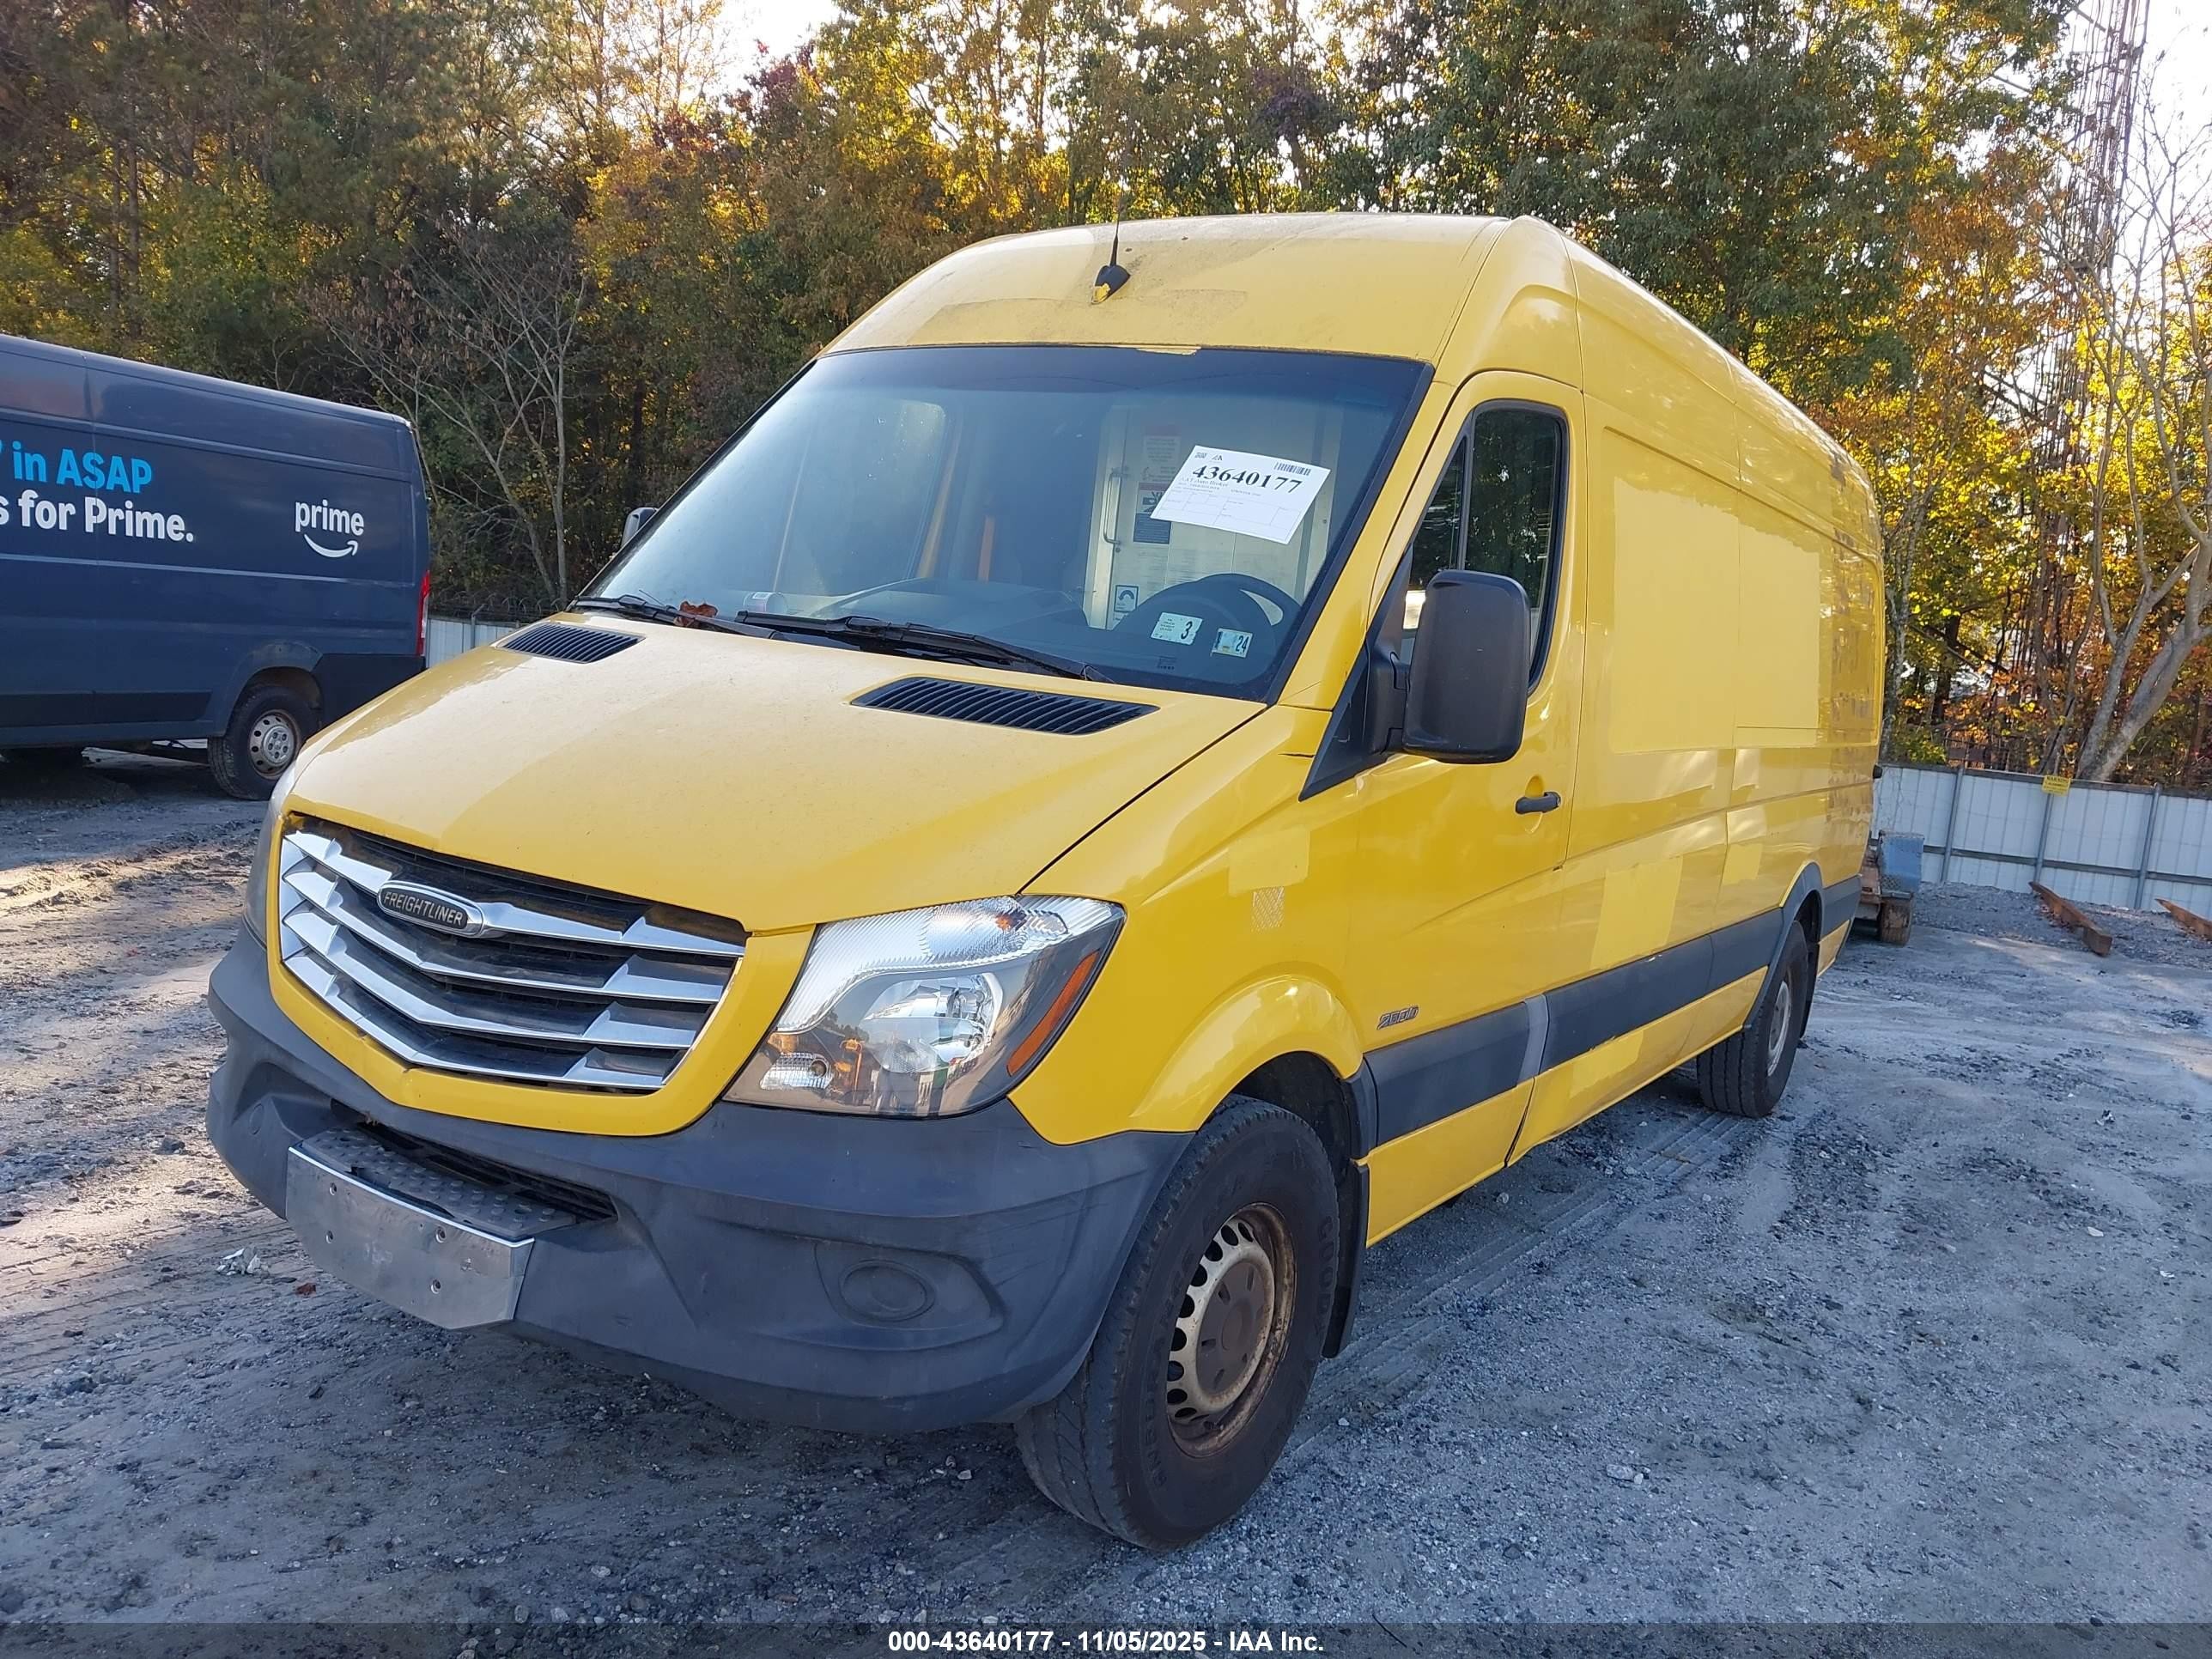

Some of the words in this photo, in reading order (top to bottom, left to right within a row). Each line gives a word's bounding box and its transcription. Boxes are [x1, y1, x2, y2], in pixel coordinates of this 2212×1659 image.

[12, 441, 47, 483] in
[56, 448, 153, 494] ASAP
[1192, 465, 1303, 493] 43640177
[18, 489, 76, 531] for
[85, 496, 194, 543] Prime.
[295, 498, 365, 537] prime
[1181, 621, 1193, 640] 3
[1235, 635, 1249, 653] 24
[383, 891, 464, 926] FREIGHTLINER
